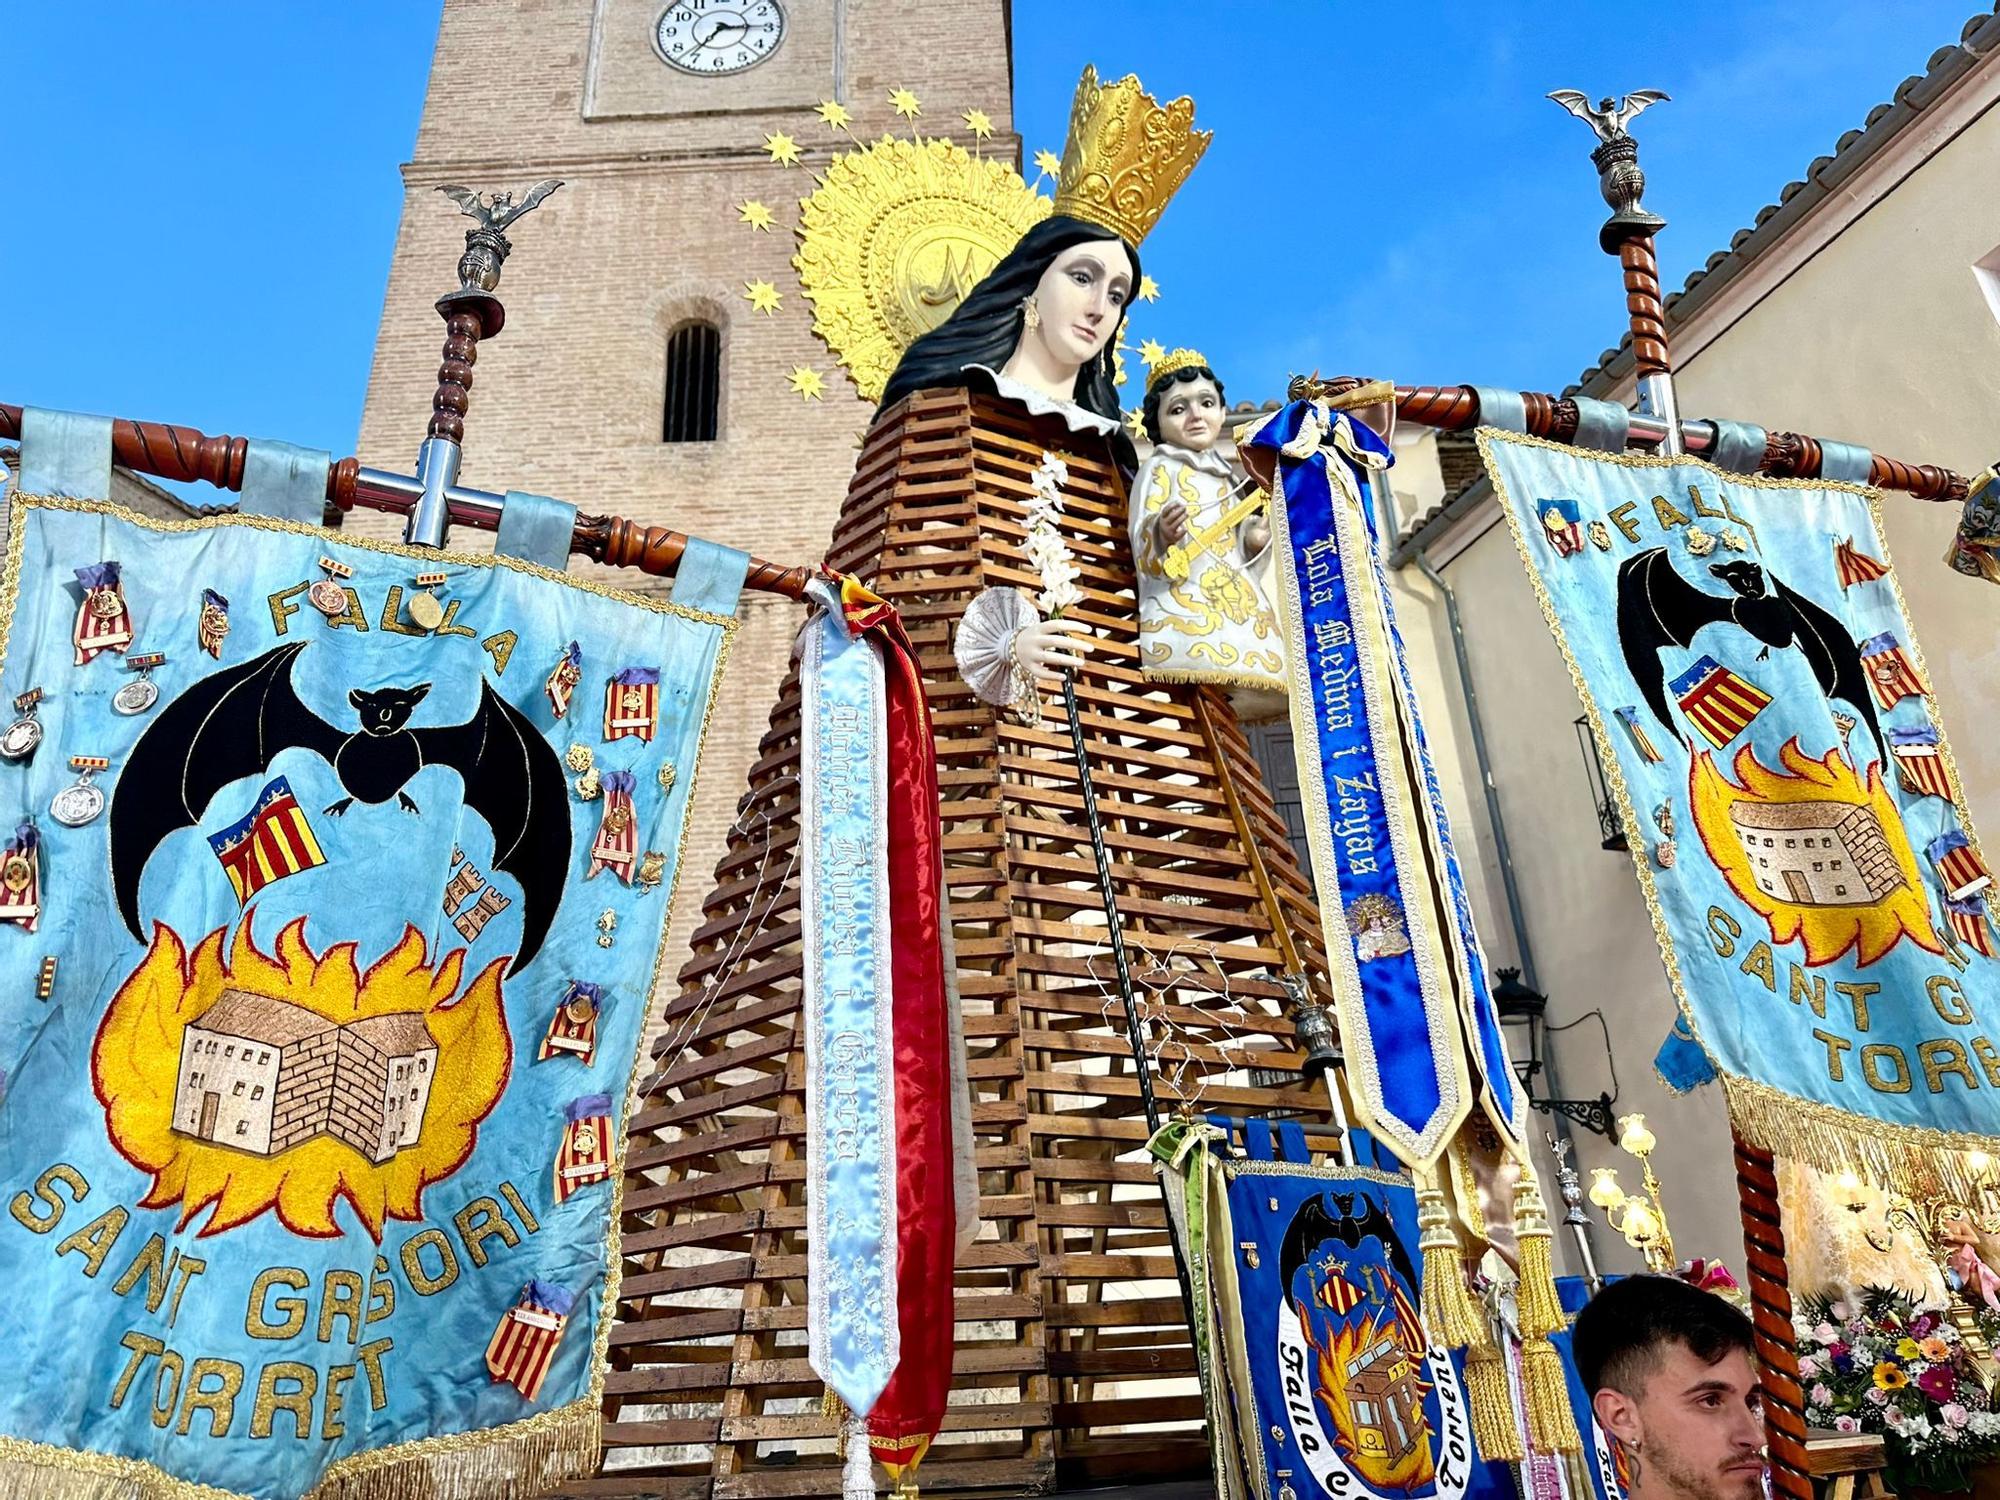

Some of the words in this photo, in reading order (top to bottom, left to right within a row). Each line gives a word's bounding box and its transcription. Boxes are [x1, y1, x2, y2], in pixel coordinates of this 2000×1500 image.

[675, 11, 692, 22] 10
[757, 6, 768, 17] 2
[666, 27, 677, 38] 9
[763, 22, 774, 33] 3
[672, 42, 684, 53] 8
[754, 38, 764, 49] 4
[690, 53, 701, 64] 7
[713, 56, 724, 68] 6
[737, 52, 748, 62] 5
[1303, 534, 1339, 608] Lola
[268, 580, 519, 677] FALLA
[1312, 618, 1354, 733] Medina
[1333, 767, 1377, 876] Zayas
[1704, 904, 1881, 1033] SANT
[9, 1163, 207, 1330] SANT
[1280, 1341, 1320, 1456] Falla
[1427, 1345, 1466, 1490] Torrent
